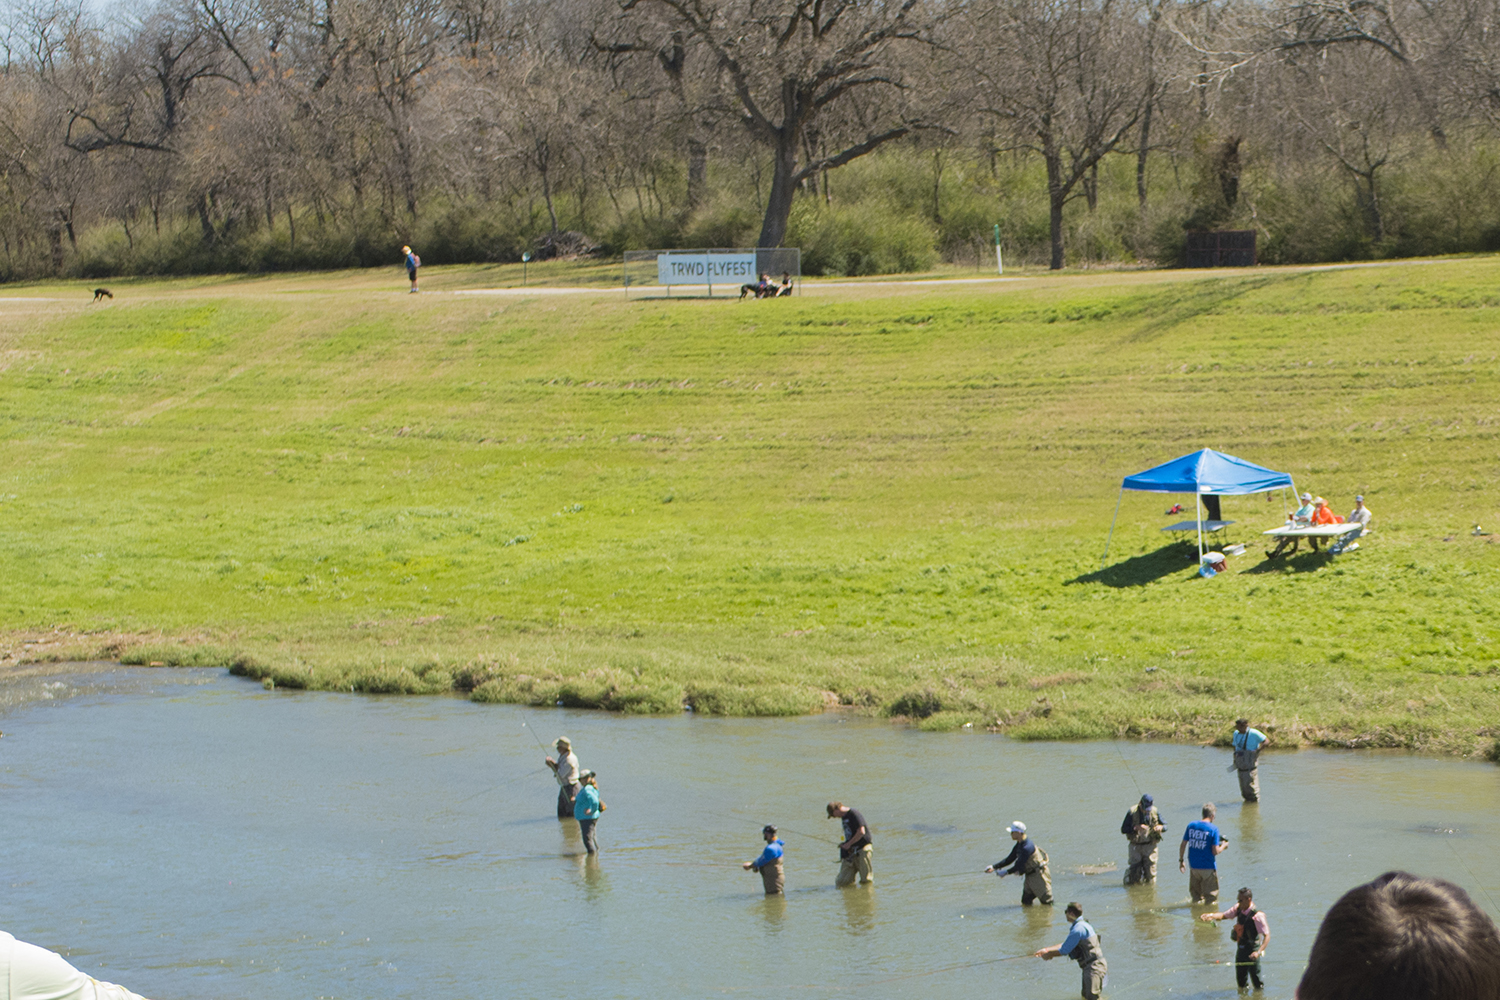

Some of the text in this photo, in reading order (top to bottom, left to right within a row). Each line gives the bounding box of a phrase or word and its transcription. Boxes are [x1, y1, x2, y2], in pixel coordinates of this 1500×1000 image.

[670, 261, 753, 276] TRWD FLYFEST
[1188, 828, 1210, 841] EVENT
[1188, 838, 1207, 850] STAFF
